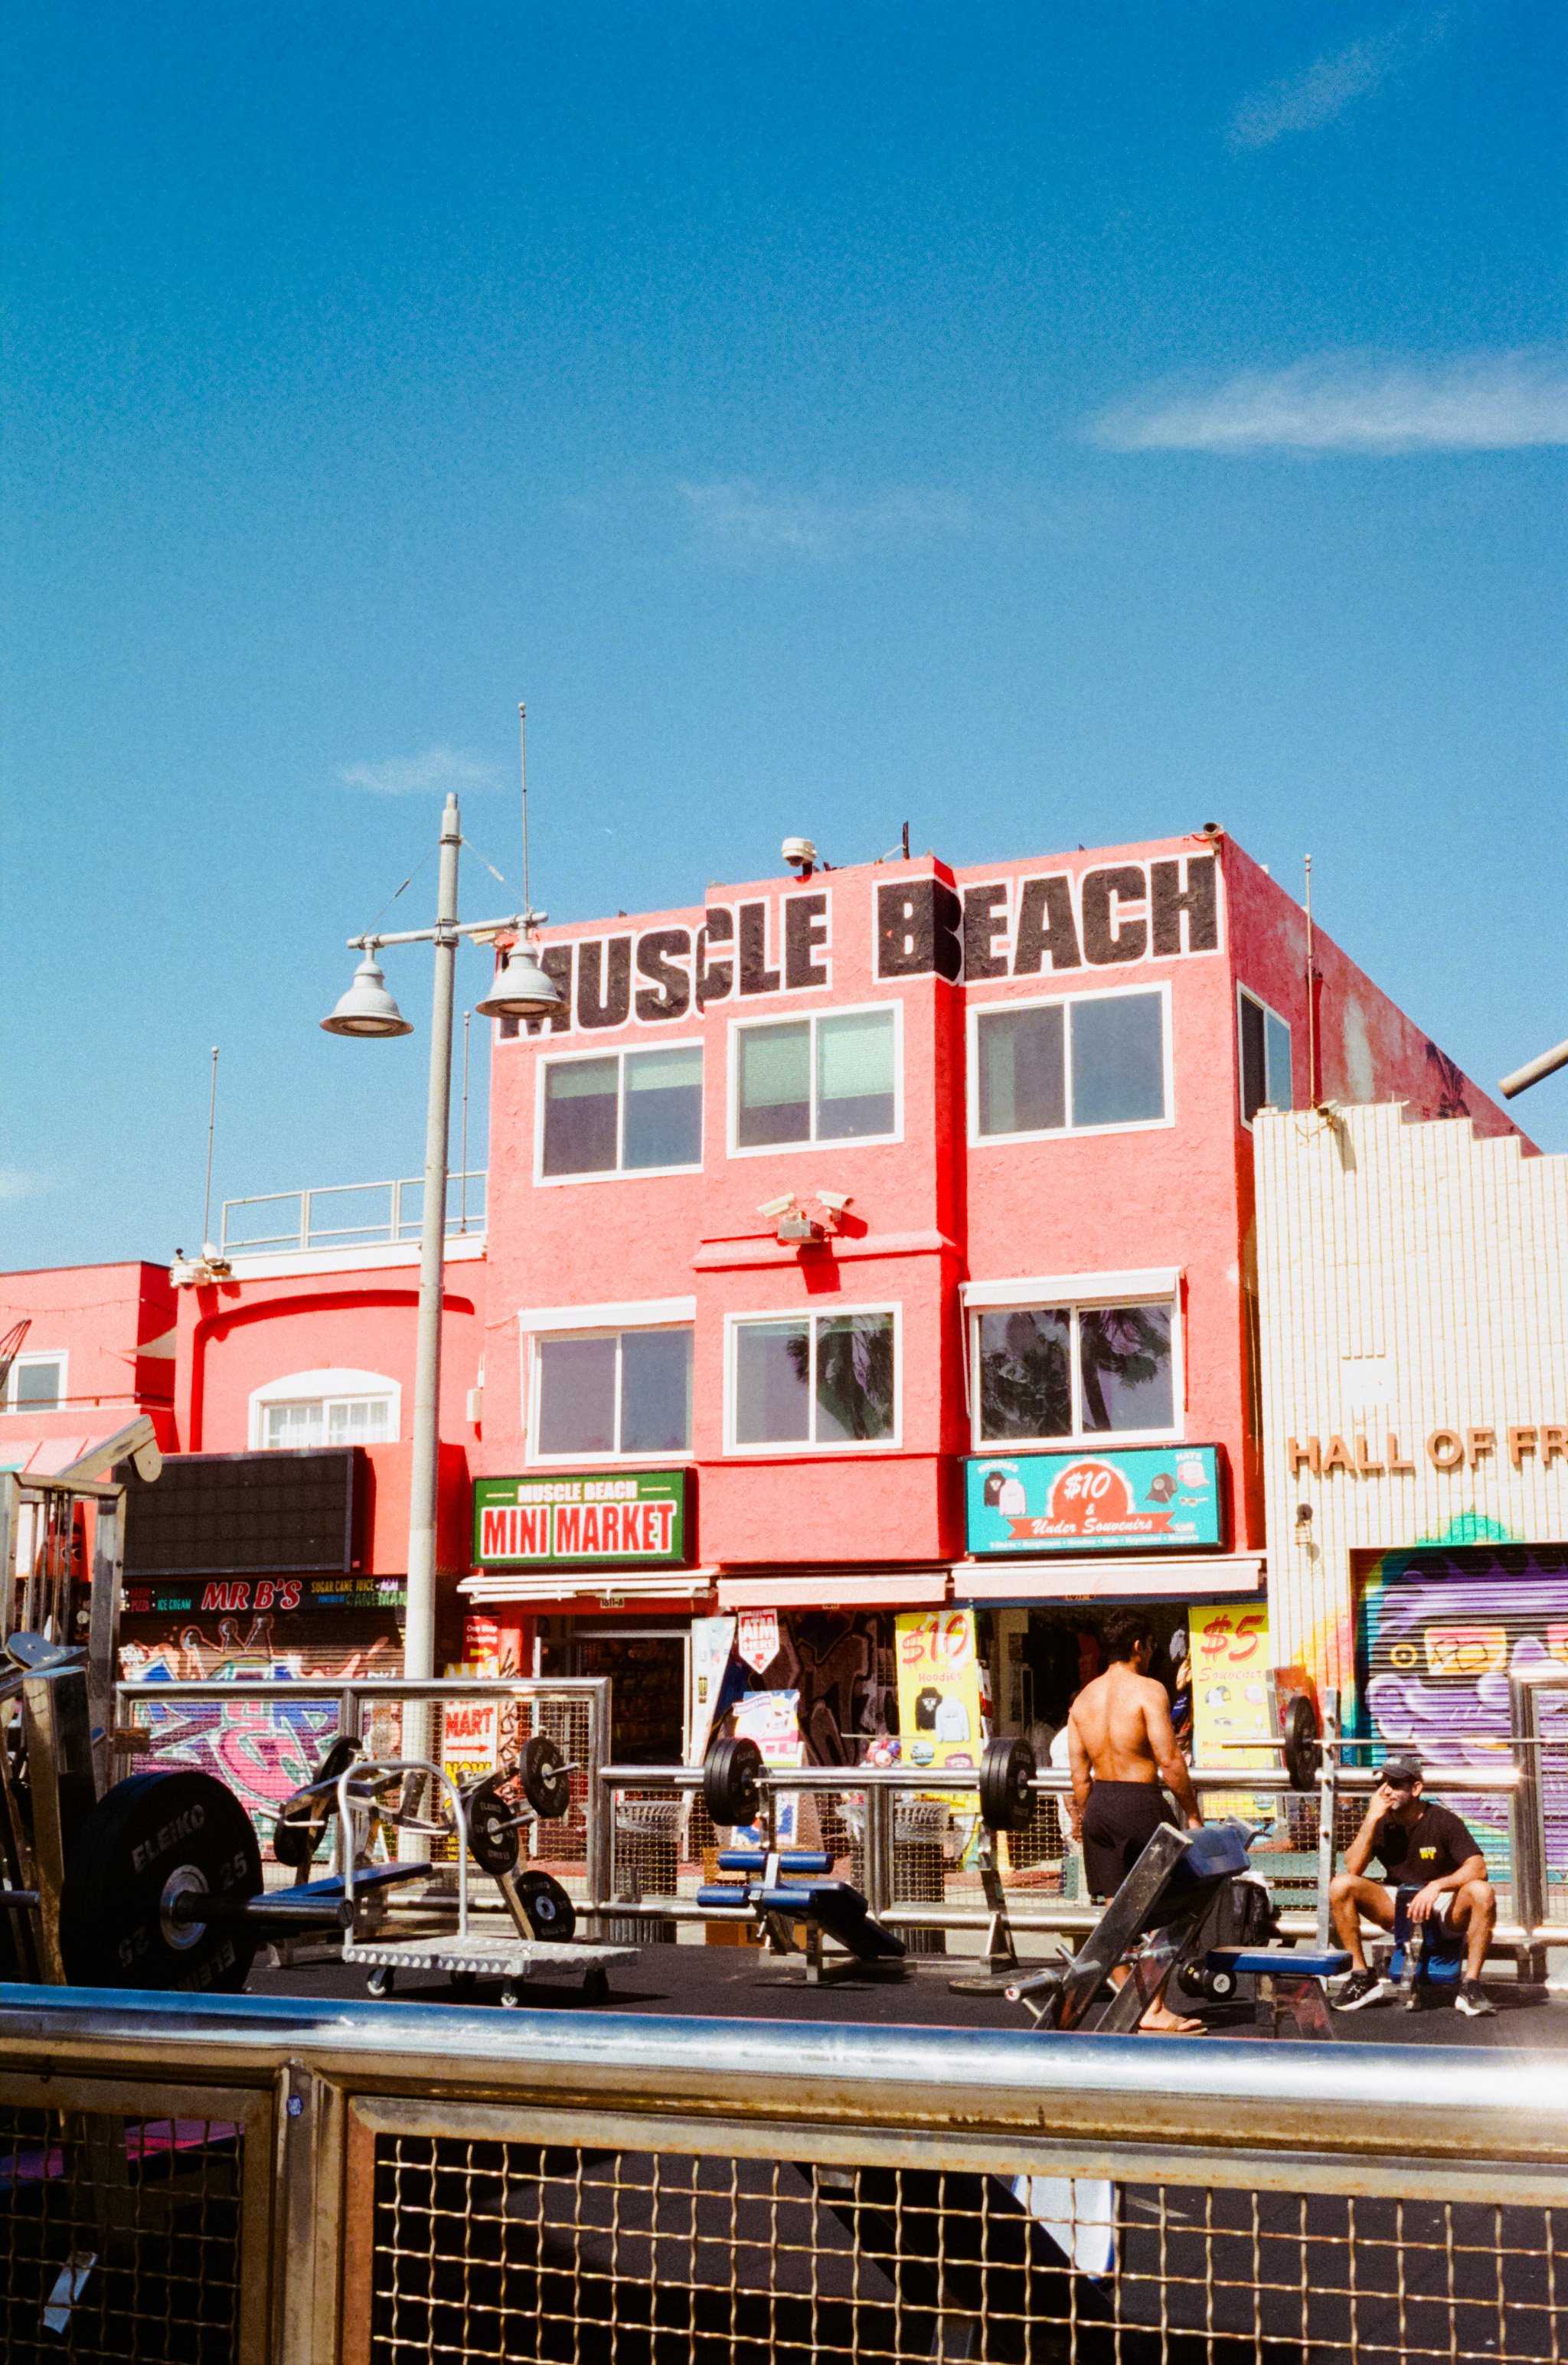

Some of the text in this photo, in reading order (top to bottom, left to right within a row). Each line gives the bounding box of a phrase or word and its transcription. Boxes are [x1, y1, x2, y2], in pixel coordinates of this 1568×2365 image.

[877, 855, 1219, 982] BEACH
[1287, 1432, 1416, 1472] HALL
[1426, 1427, 1495, 1467] OF
[517, 1481, 639, 1504] MUSCLE BEACH
[1063, 1470, 1112, 1500] $10
[1085, 1503, 1095, 1516] &
[482, 1501, 675, 1557] MINI MARKET
[1031, 1518, 1076, 1535] Under
[1081, 1517, 1153, 1534] Souvenirs
[201, 1578, 302, 1610] MR B'S
[466, 1624, 481, 1633] One
[466, 1634, 498, 1645] Shopping
[740, 1617, 776, 1641] ATM
[901, 1613, 969, 1669] $10
[1200, 1613, 1266, 1662] $5
[918, 1671, 962, 1683] Hoodies
[445, 1707, 494, 1739] MART
[131, 1803, 205, 1876] ELEIKO
[219, 1851, 248, 1892] 25
